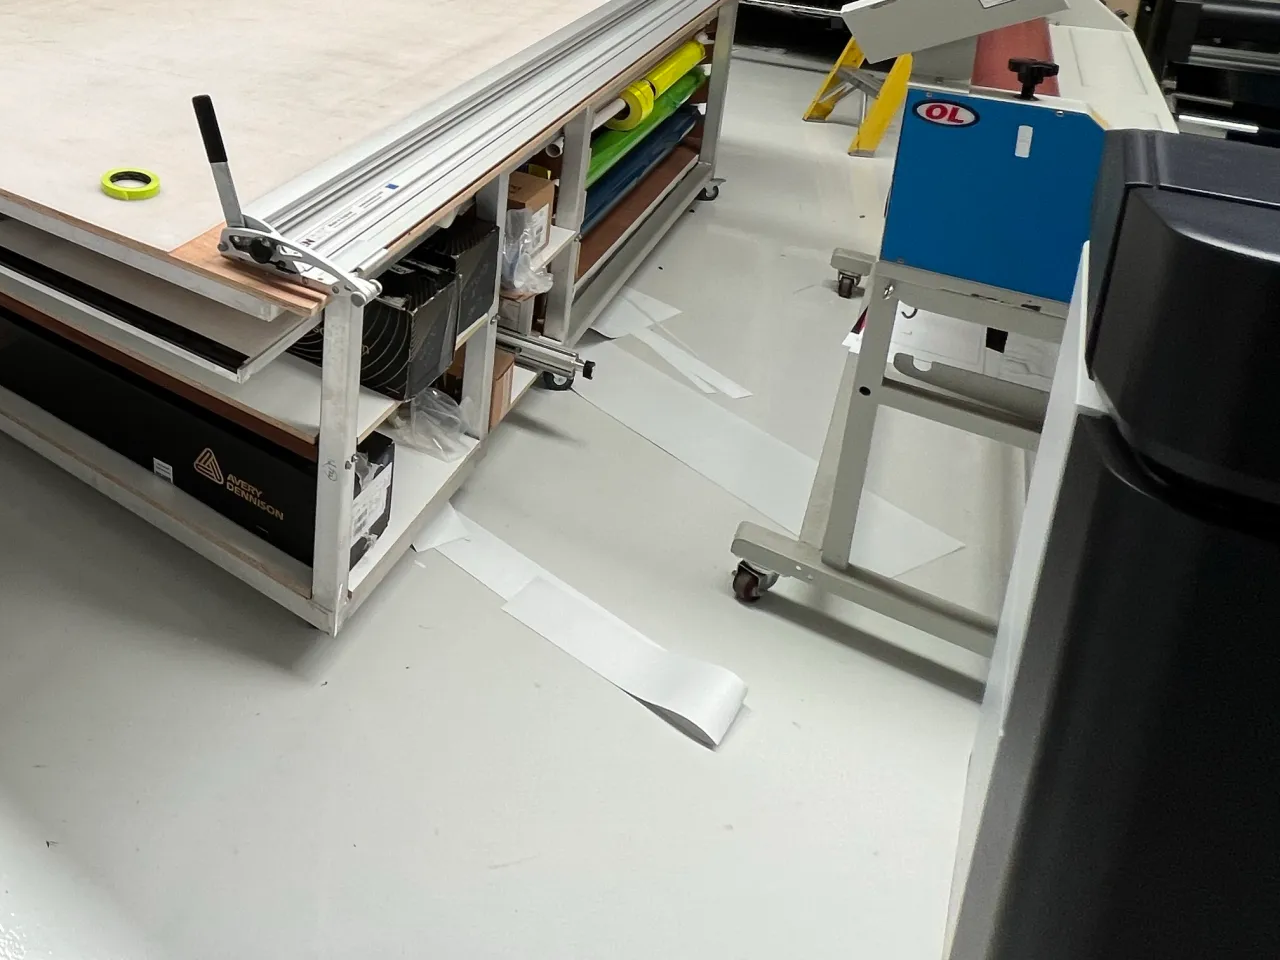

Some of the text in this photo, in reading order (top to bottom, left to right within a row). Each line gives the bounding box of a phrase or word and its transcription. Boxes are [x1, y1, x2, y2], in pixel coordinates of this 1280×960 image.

[925, 104, 964, 124] OL
[226, 473, 263, 497] AVERY
[225, 481, 285, 521] DENNISON
